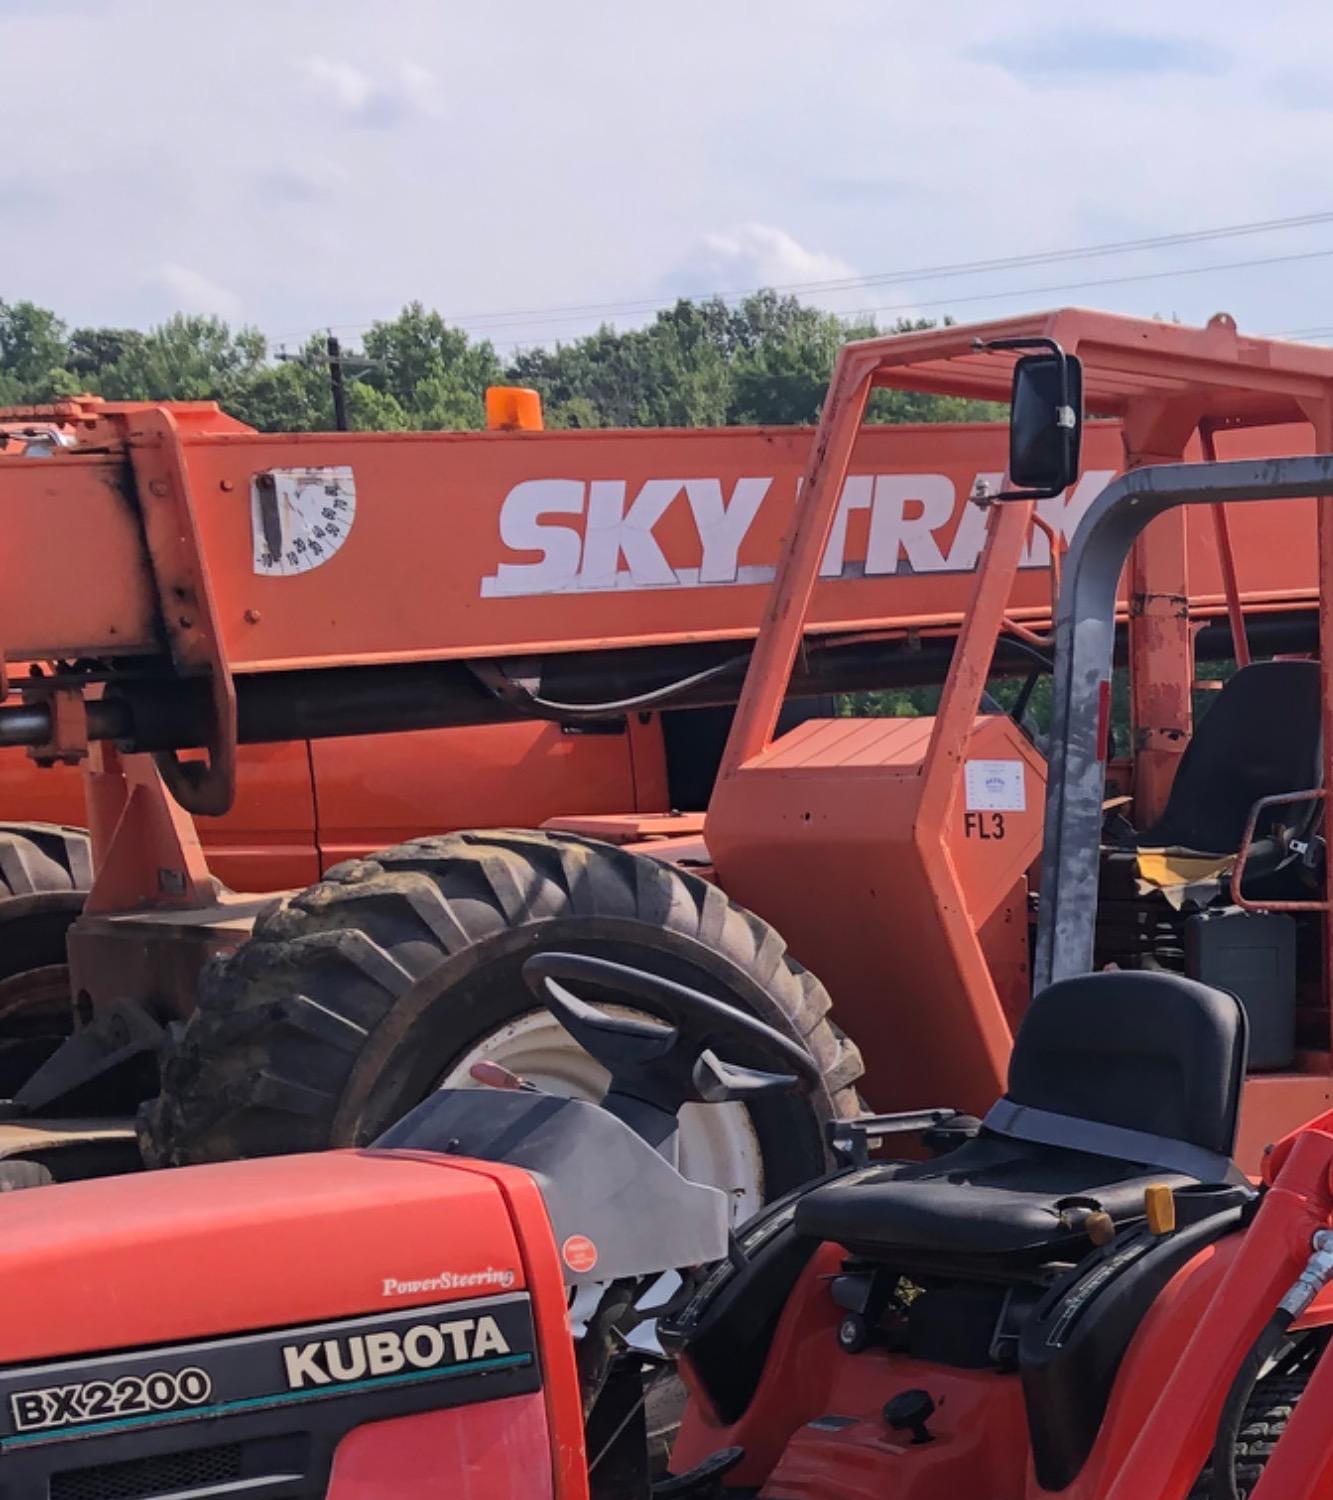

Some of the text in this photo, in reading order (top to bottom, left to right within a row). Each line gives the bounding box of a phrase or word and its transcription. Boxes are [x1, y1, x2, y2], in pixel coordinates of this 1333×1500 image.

[497, 475, 773, 587] SKY
[963, 812, 1006, 840] FL3
[382, 1266, 516, 1297] PowerSteering
[282, 1314, 512, 1389] KUBOTA
[11, 1366, 212, 1432] BX2200
